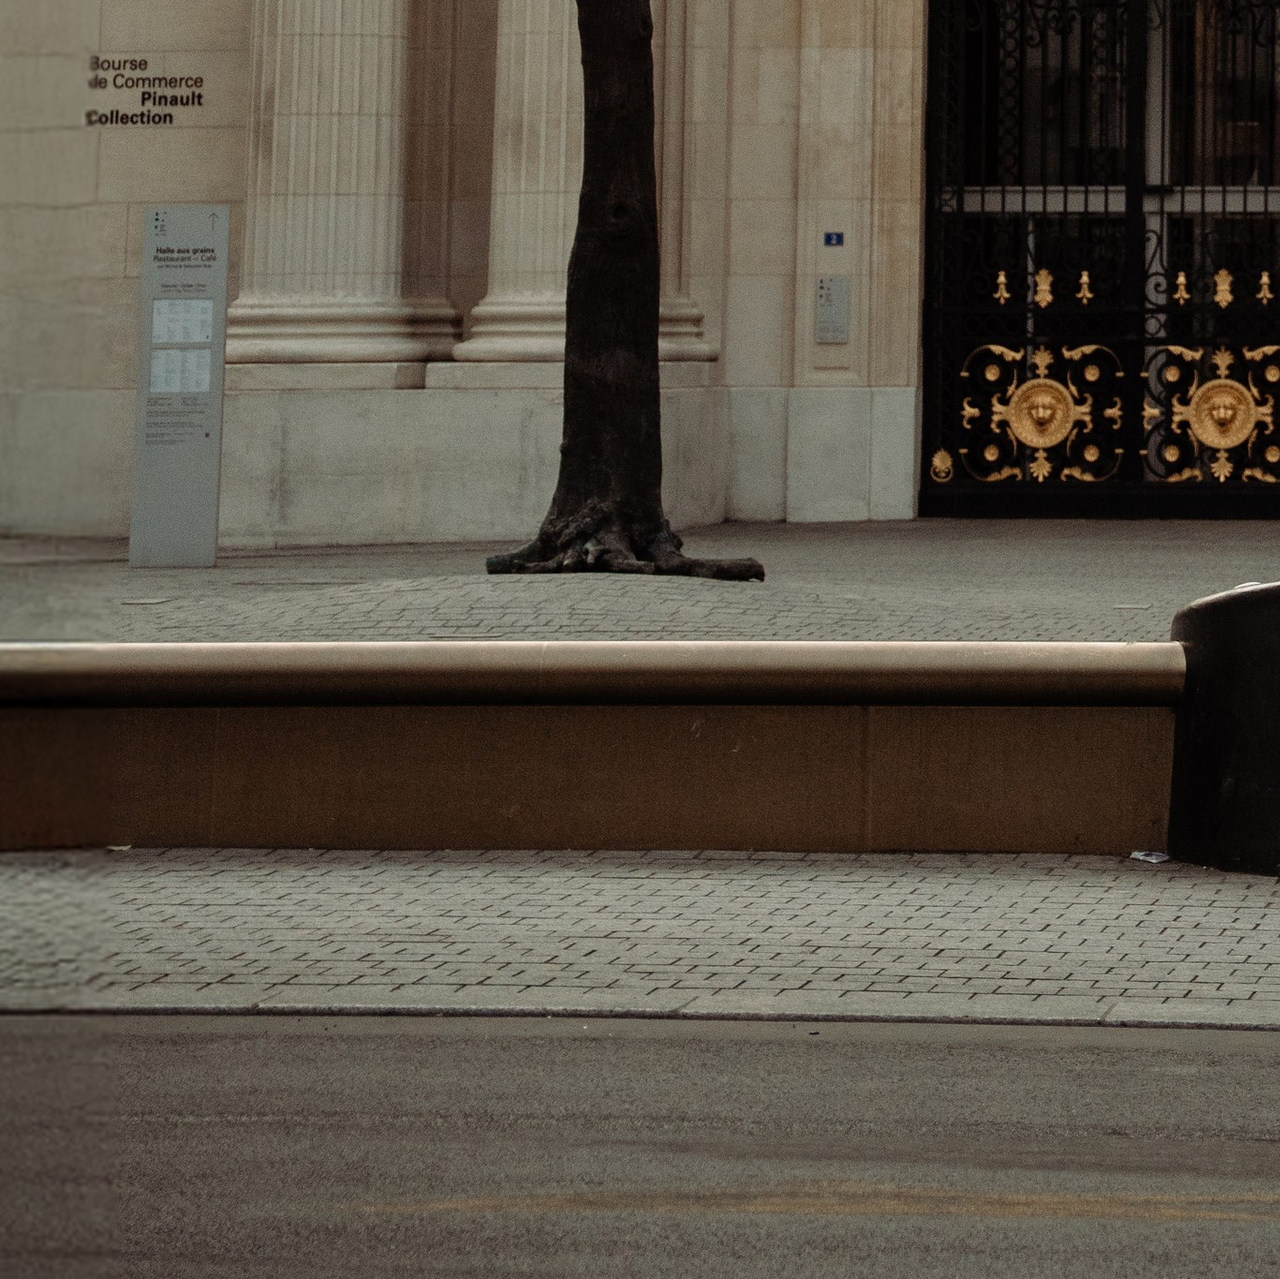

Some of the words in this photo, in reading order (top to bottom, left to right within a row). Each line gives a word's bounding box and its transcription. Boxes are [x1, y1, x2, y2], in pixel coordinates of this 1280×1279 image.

[90, 55, 148, 72] Bourse
[88, 74, 108, 90] de
[113, 73, 204, 90] Commerce
[141, 92, 204, 107] Pinault
[86, 110, 174, 126] Collection
